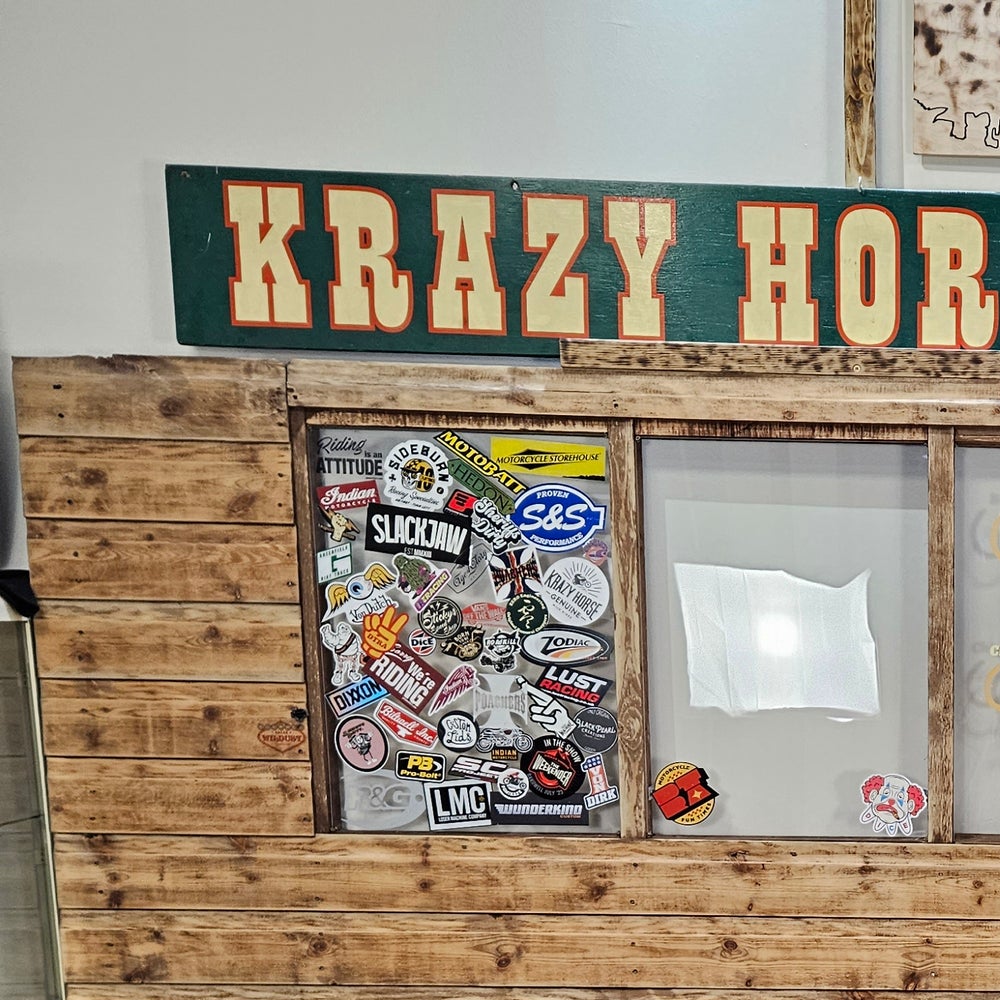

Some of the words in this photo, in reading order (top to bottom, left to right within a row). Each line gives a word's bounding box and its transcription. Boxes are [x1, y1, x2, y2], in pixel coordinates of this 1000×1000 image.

[223, 180, 675, 338] KRAZY
[316, 437, 367, 456] Riding
[316, 457, 383, 476] ATTITUDE
[388, 444, 450, 482] SIDEBURN
[439, 431, 527, 494] MOTOBATT
[496, 455, 547, 464] MOTORCYCLE
[549, 453, 600, 463] STOREHOUSE
[320, 486, 375, 505] Indian
[453, 464, 509, 511] HEDON
[536, 490, 570, 499] PROVEN
[519, 503, 588, 531] S&S
[371, 514, 468, 555] SLACKJAW
[529, 532, 584, 547] PERFORMANCE
[544, 569, 576, 598] KRAZY
[572, 592, 602, 620] HORSE
[550, 593, 581, 618] GENUINE
[367, 634, 388, 649] DTRA
[541, 636, 590, 656] ZODIAC
[369, 655, 430, 707] RIDING
[407, 661, 436, 690] We're
[545, 665, 608, 693] LUST
[333, 680, 383, 711] DIXXON
[539, 678, 600, 703] RACING
[380, 705, 418, 732] Biltwell
[446, 718, 472, 733] CUSTOM
[543, 739, 553, 747] IN
[553, 738, 564, 749] THE
[564, 743, 582, 763] SHOW
[400, 769, 439, 779] Pro-Bolt
[407, 755, 434, 771] PB
[452, 756, 508, 773] SC
[532, 754, 573, 787] WEEKENDER
[550, 761, 560, 769] THE
[657, 764, 691, 786] MOTORCYCLE
[433, 785, 486, 817] LMC
[494, 803, 583, 815] WUNDERKIND
[587, 788, 617, 808] DIRK
[697, 802, 712, 820] TIMES
